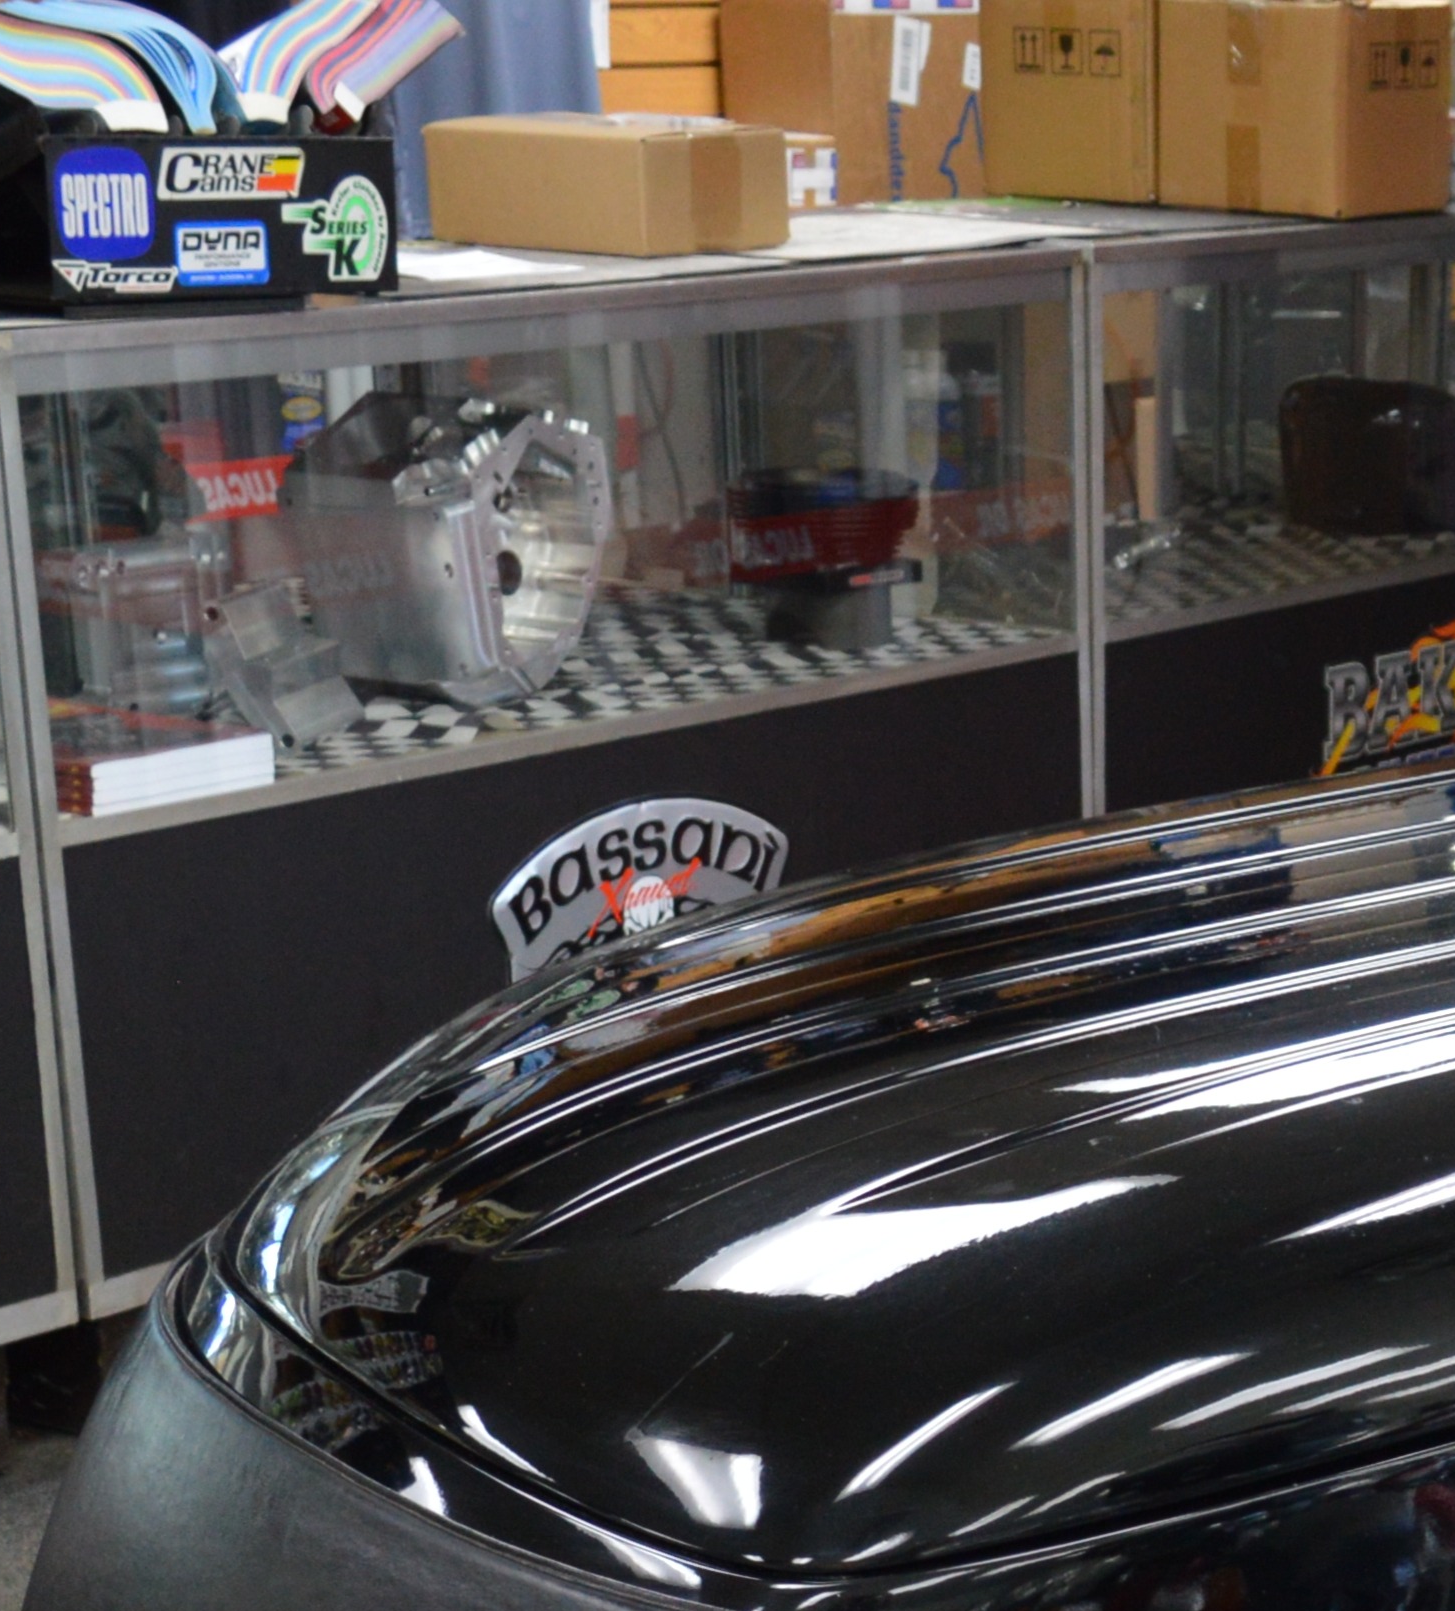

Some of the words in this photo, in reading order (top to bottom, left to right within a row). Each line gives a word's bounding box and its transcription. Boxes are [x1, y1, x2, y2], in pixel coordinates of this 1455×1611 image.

[165, 153, 276, 193] CRANE
[61, 173, 150, 239] SPECTRO
[310, 206, 367, 235] SERIES
[182, 231, 260, 251] DYNA
[333, 239, 360, 276] K
